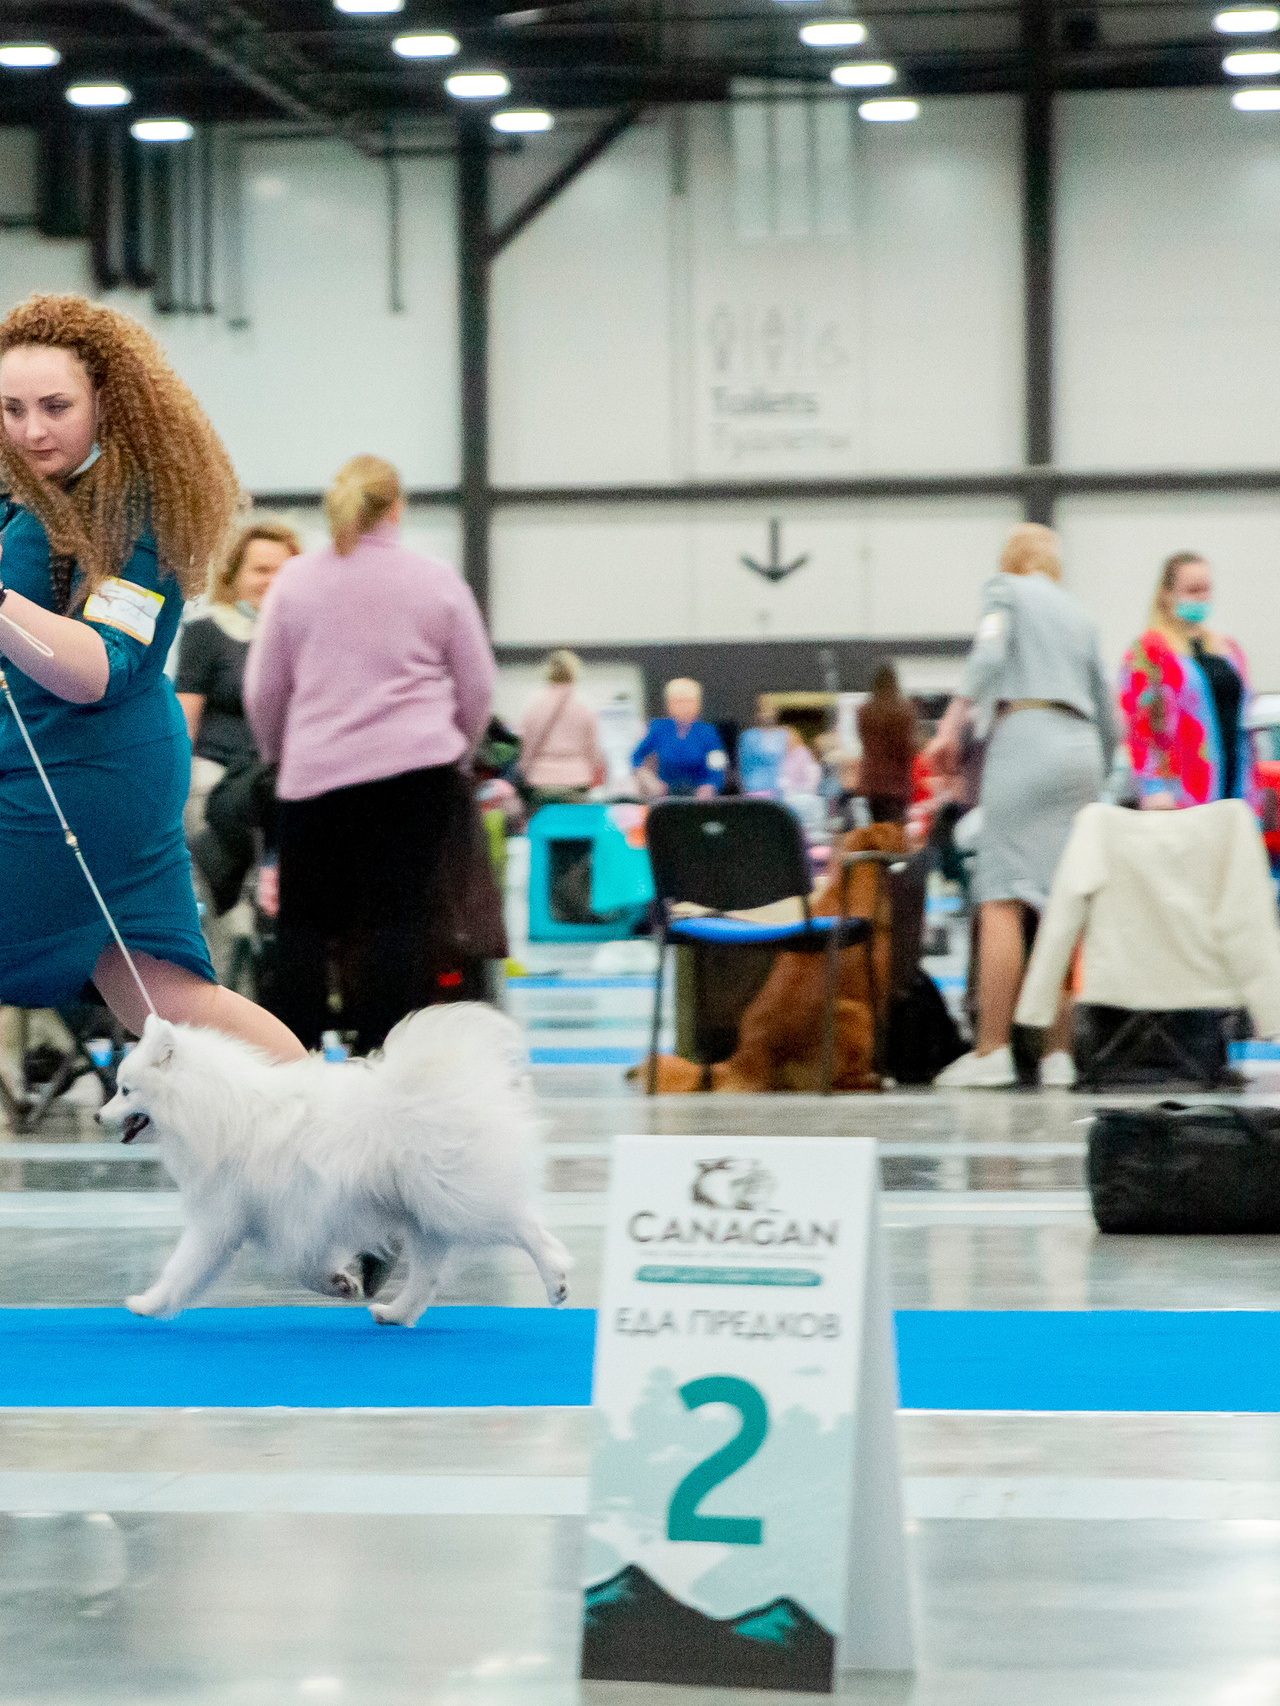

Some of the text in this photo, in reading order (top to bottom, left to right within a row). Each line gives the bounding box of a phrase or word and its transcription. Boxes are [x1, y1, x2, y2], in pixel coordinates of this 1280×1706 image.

[628, 1210, 839, 1246] CANAGAN
[615, 1307, 840, 1339] ЕДА ПРЕДКОВ
[666, 1374, 769, 1545] 2
